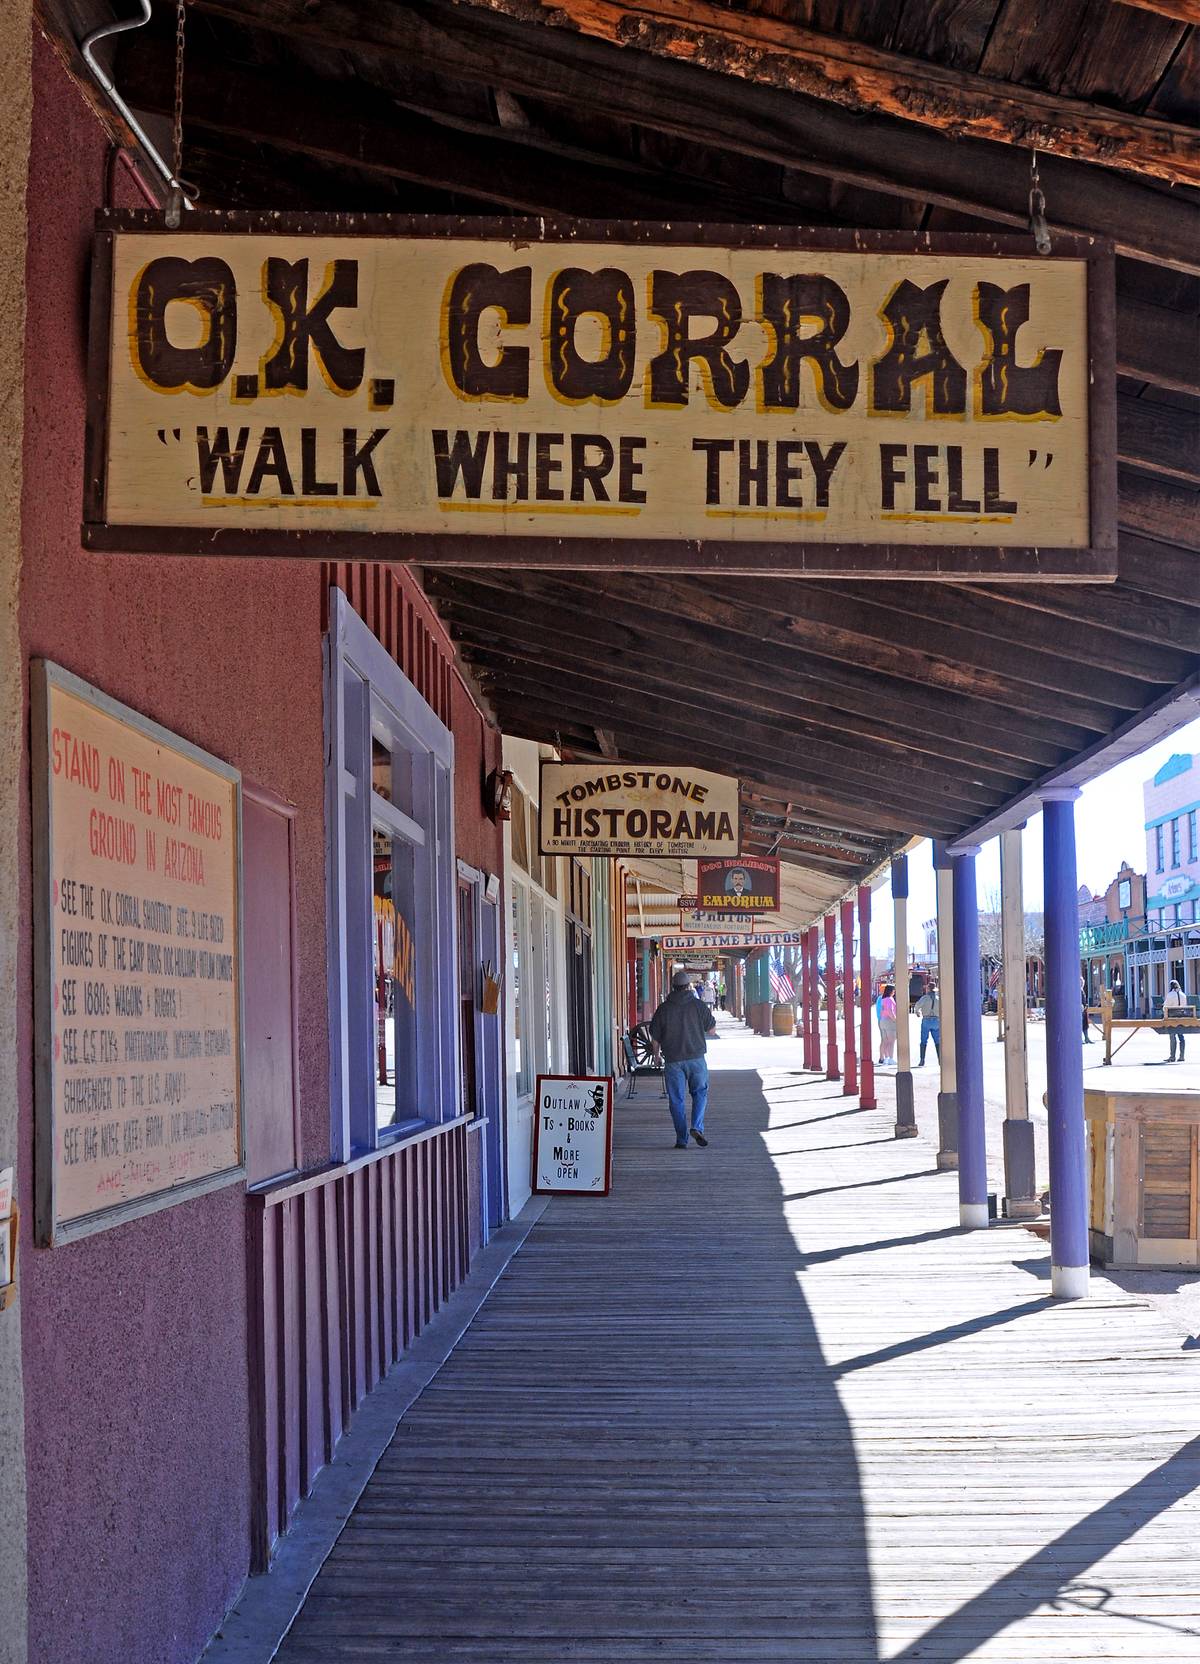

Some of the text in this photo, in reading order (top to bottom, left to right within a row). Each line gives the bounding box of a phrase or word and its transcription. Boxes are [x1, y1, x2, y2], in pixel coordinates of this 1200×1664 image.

[129, 256, 1064, 422] O.K. CORRAL
[432, 428, 648, 505] WHERE
[692, 438, 847, 508] THEY
[52, 727, 222, 841] STAND ON THE MOST FAMOUS
[556, 772, 709, 808] TOMBSTONE
[553, 808, 735, 841] HISTORAMA
[89, 808, 206, 888] GROUND IN ARIZONA
[61, 878, 77, 916] SEE
[80, 884, 94, 920] THE
[116, 892, 141, 929] CORRAL
[143, 898, 172, 935] SHOOTOUT
[197, 911, 208, 941] LIFE
[679, 899, 696, 907] SSW
[703, 895, 775, 909] EMPORIUM
[61, 929, 93, 968] FIGURES
[98, 933, 108, 969] OF
[112, 935, 126, 971] THE
[129, 938, 145, 972] EARP
[665, 932, 800, 948] OLD TIME PHOTOS
[62, 979, 77, 1016] SEE
[114, 983, 143, 1017] WAGONS
[63, 1028, 78, 1064] SEE
[64, 1076, 112, 1114] SURRENDER
[117, 1076, 126, 1109] TO
[130, 1073, 145, 1107] THE
[63, 1126, 79, 1165] SEE
[557, 1167, 579, 1179] OPEN
